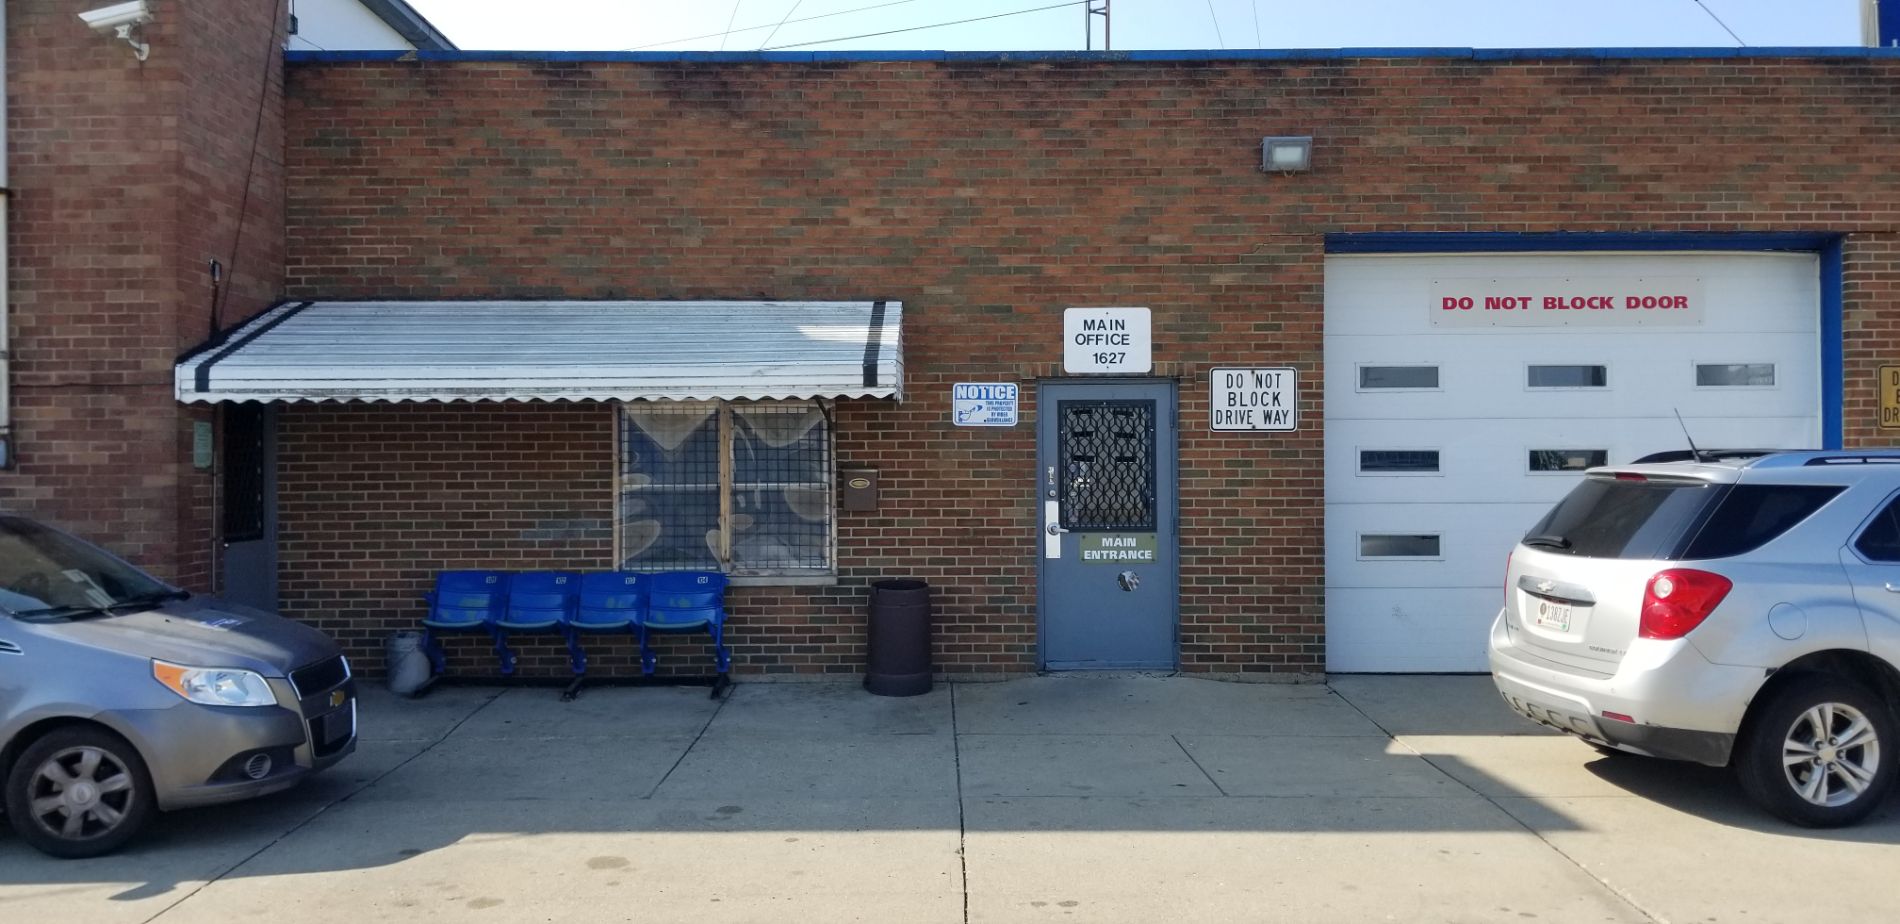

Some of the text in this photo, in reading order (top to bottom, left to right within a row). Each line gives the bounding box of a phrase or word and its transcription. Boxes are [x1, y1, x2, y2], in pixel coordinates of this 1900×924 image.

[1442, 295, 1689, 310] DO NOT BLOCK DOOR
[1083, 319, 1126, 331] MAIN
[1075, 333, 1130, 346] OFFICE
[1092, 352, 1126, 364] 1627
[1226, 373, 1281, 389] DO NOT
[956, 385, 1015, 399] NOTICE
[1228, 391, 1281, 407] BLOCK
[1215, 409, 1289, 425] DRIVE WAY
[1102, 537, 1137, 547] MAIN
[1083, 550, 1152, 560] ENTRANCE
